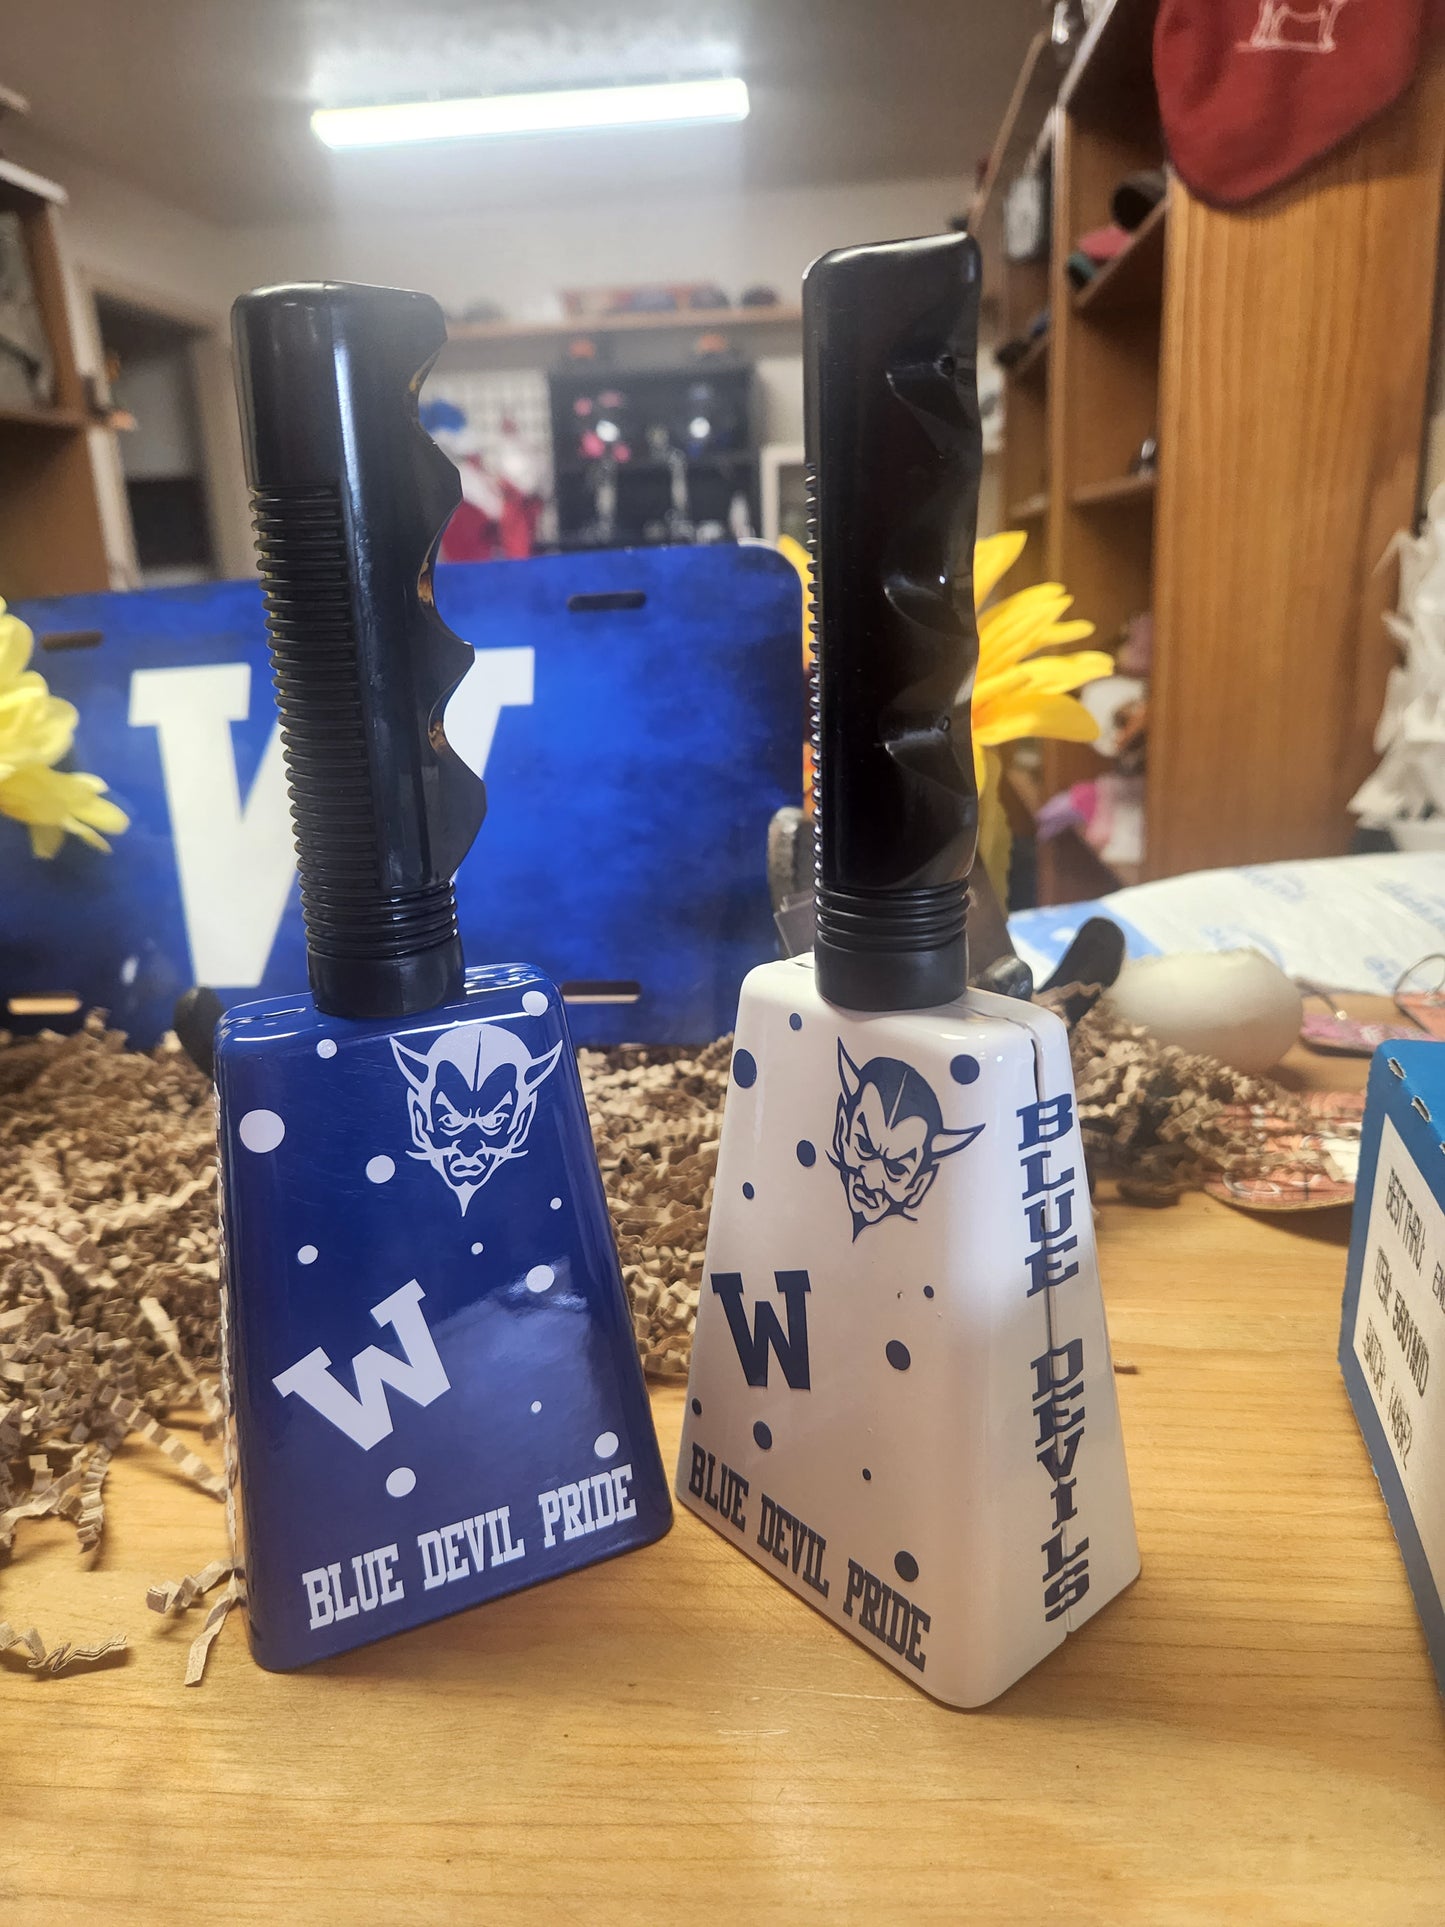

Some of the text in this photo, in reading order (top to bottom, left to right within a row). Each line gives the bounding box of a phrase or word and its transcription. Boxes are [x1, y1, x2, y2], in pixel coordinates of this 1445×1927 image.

[1385, 1165, 1407, 1235] BEST
[271, 1278, 451, 1451] W
[710, 1269, 811, 1391] W
[1016, 1092, 1091, 1623] BLUE DEVILS
[302, 1464, 637, 1631] BLUE DEVIL PRIDE
[688, 1442, 931, 1673] BLUE DEVIL PRIDE
